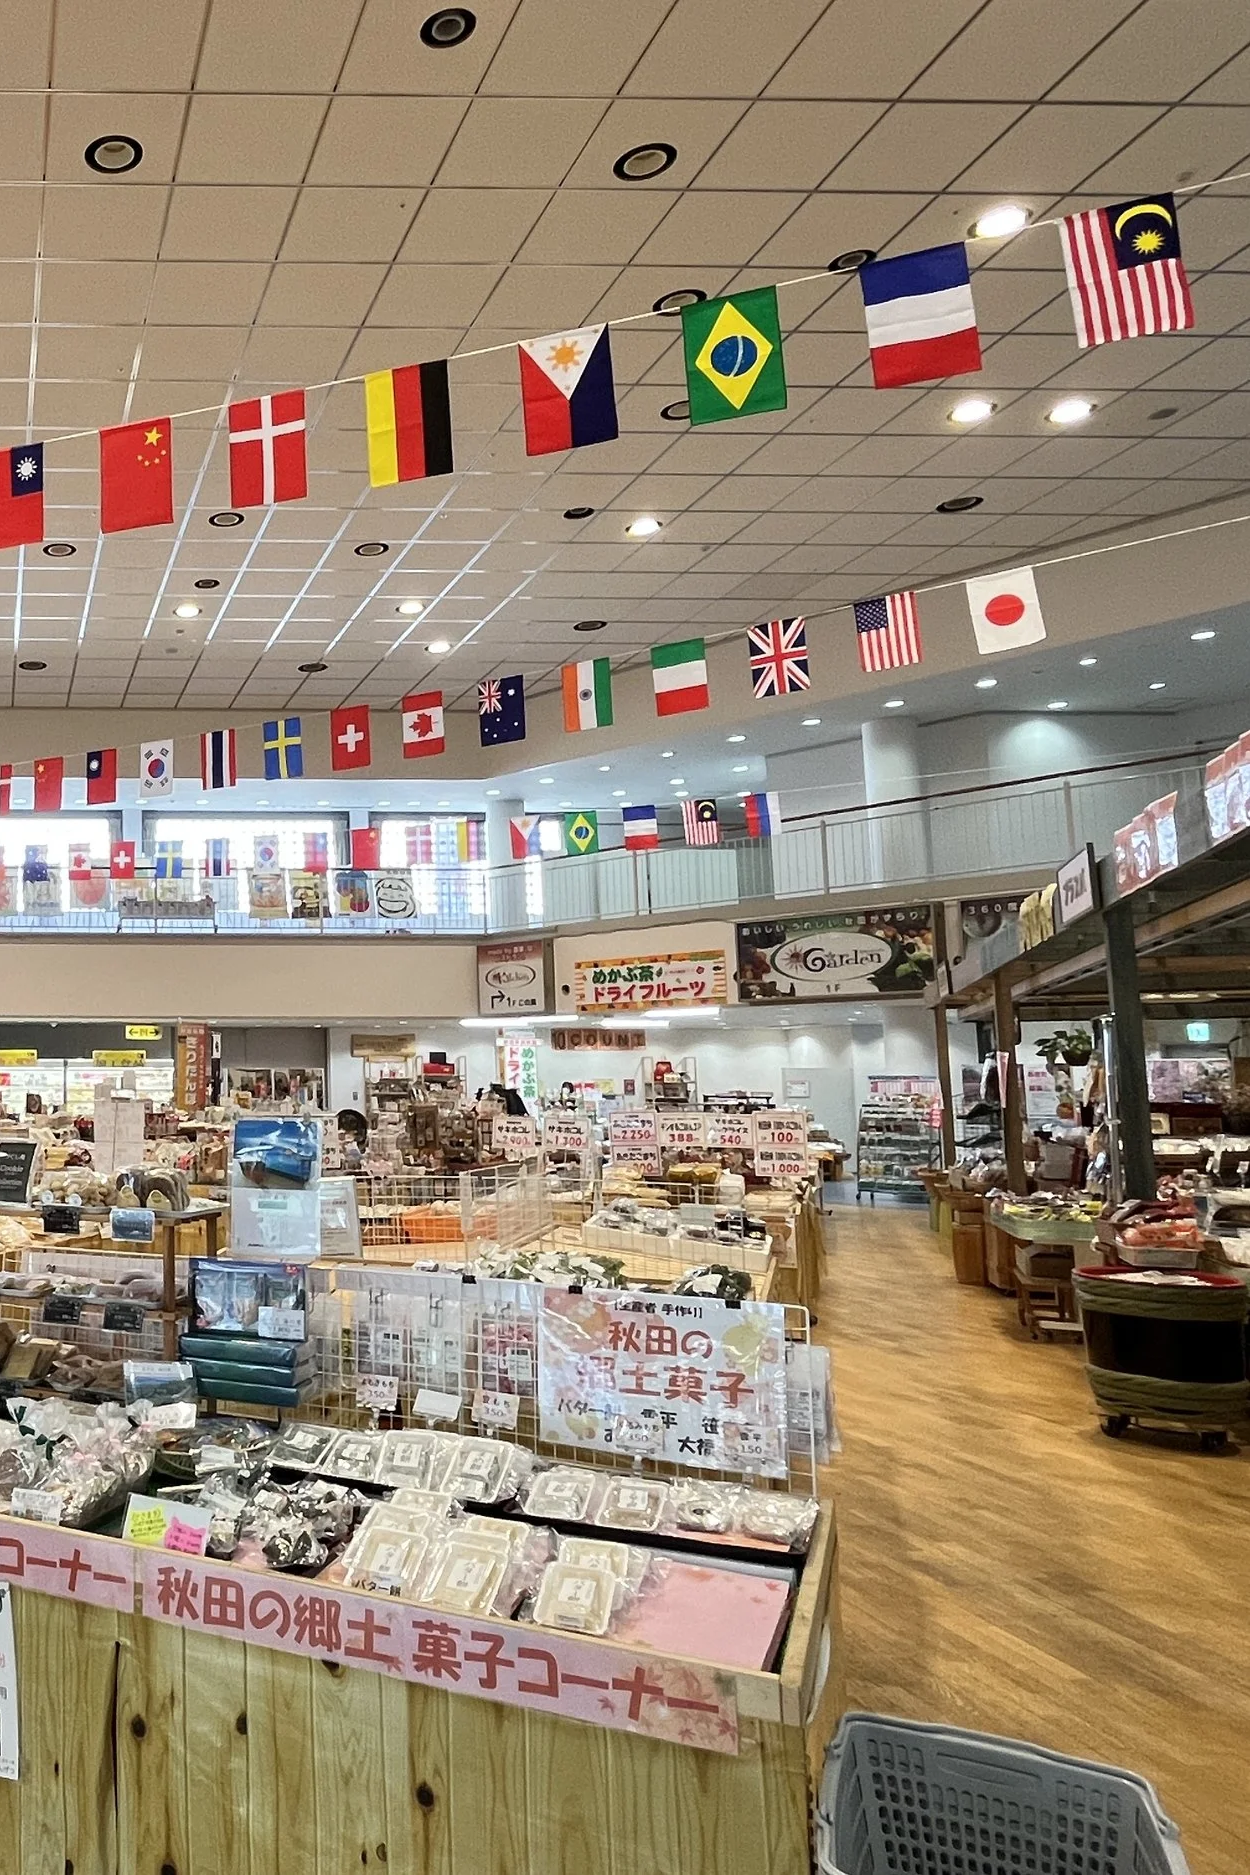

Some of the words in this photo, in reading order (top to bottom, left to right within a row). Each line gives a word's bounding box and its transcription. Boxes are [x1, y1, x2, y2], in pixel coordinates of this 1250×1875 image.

[803, 947, 882, 973] Garden
[592, 965, 654, 984] めかぶ茶
[593, 981, 706, 1002] ドライフルーツ
[521, 1047, 536, 1098] めかぶ茶
[497, 1126, 531, 1134] サキホコレ
[548, 1125, 584, 1135] サキホコレ
[608, 1321, 714, 1359] 秋田の
[355, 1578, 401, 1597] バター餅
